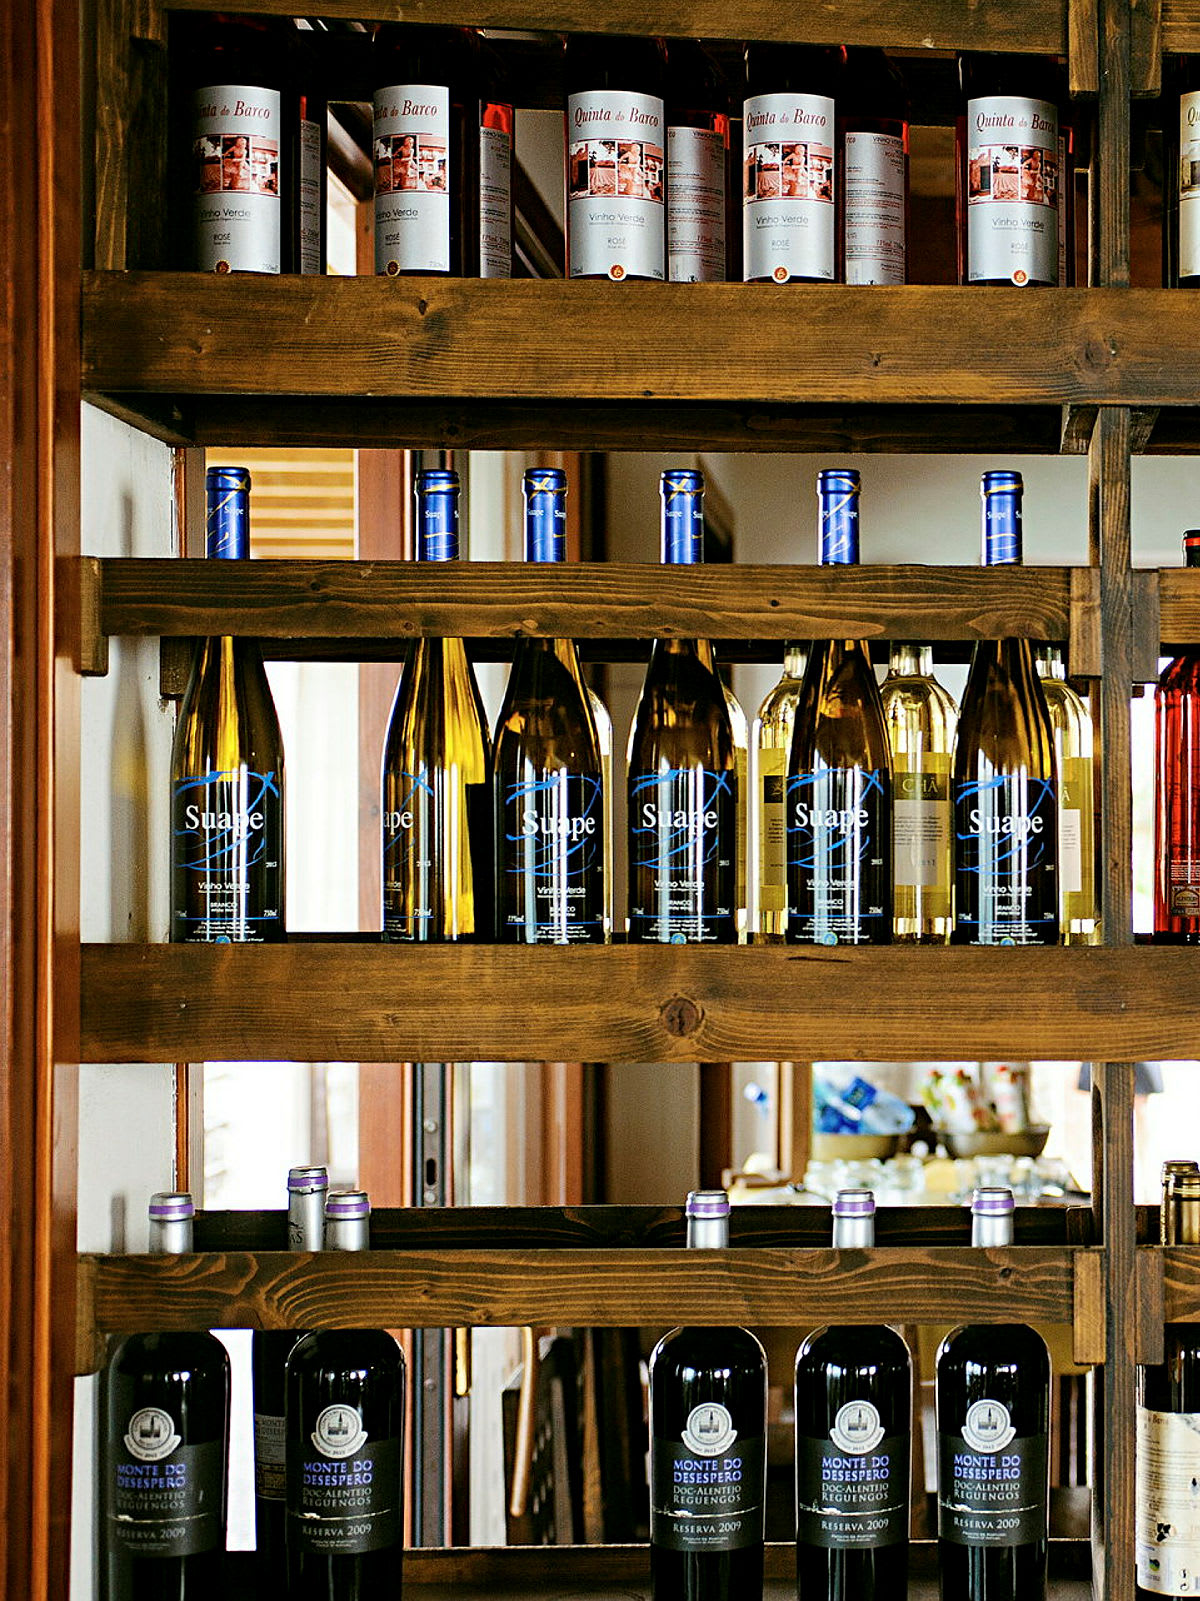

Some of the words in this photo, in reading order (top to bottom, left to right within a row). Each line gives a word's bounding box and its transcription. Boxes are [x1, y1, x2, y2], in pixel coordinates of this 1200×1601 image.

[234, 100, 271, 119] Barco
[402, 100, 438, 116] Barco
[574, 107, 612, 128] Quinta
[629, 107, 660, 126] Barco
[747, 111, 776, 132] Quinta
[794, 109, 826, 126] Barco
[977, 112, 1014, 131] Quinta
[588, 213, 615, 221] Vinho
[185, 805, 264, 838] Suape
[384, 811, 414, 836] ape
[522, 810, 596, 841] Suape
[643, 804, 718, 836] Suape
[795, 803, 869, 834] Suape
[970, 809, 1043, 841] Suape
[304, 1462, 347, 1473] MONTE
[353, 1460, 373, 1472] DO
[674, 1459, 718, 1471] MONTE
[723, 1458, 742, 1470] DO
[822, 1457, 867, 1469] MONTE
[872, 1455, 890, 1467] DO
[954, 1454, 996, 1467] MONTE
[1002, 1455, 1021, 1467] DO
[117, 1465, 158, 1476] MONTE
[166, 1464, 186, 1475] DO
[673, 1470, 742, 1484] DESESPERO
[822, 1468, 890, 1482] DESESPERO
[954, 1467, 1021, 1480] DESESPERO
[117, 1476, 186, 1488] DESESPERO
[303, 1473, 373, 1486] DESESPERO
[347, 1524, 372, 1536] 2009
[718, 1521, 742, 1533] 2009
[867, 1518, 889, 1530] 2009
[996, 1517, 1020, 1529] 2009
[160, 1528, 186, 1539] 2009
